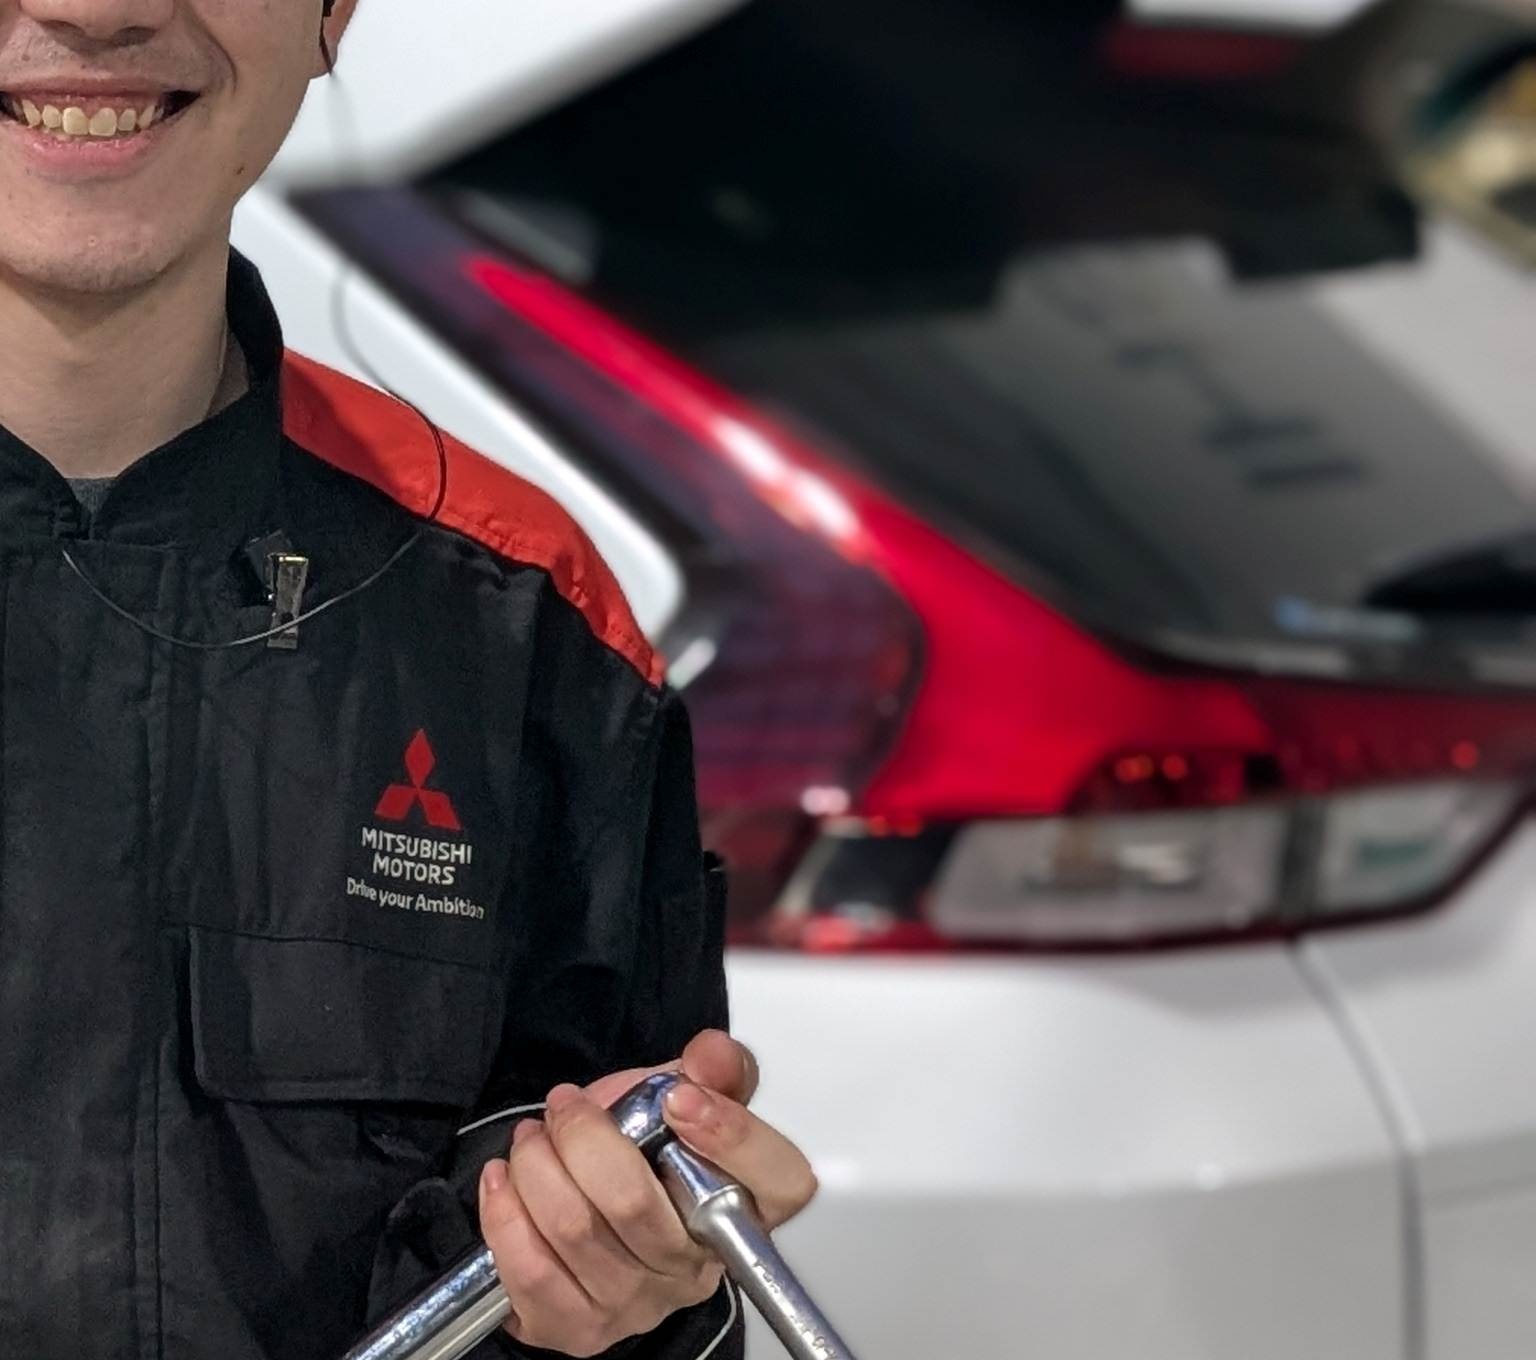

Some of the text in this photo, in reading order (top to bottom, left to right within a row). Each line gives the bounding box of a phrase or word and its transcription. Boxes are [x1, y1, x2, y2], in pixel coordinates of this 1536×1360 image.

[360, 826, 473, 865] MITSUBISHI
[372, 851, 457, 886] MOTORS
[346, 876, 485, 920] Drive your Ambition
